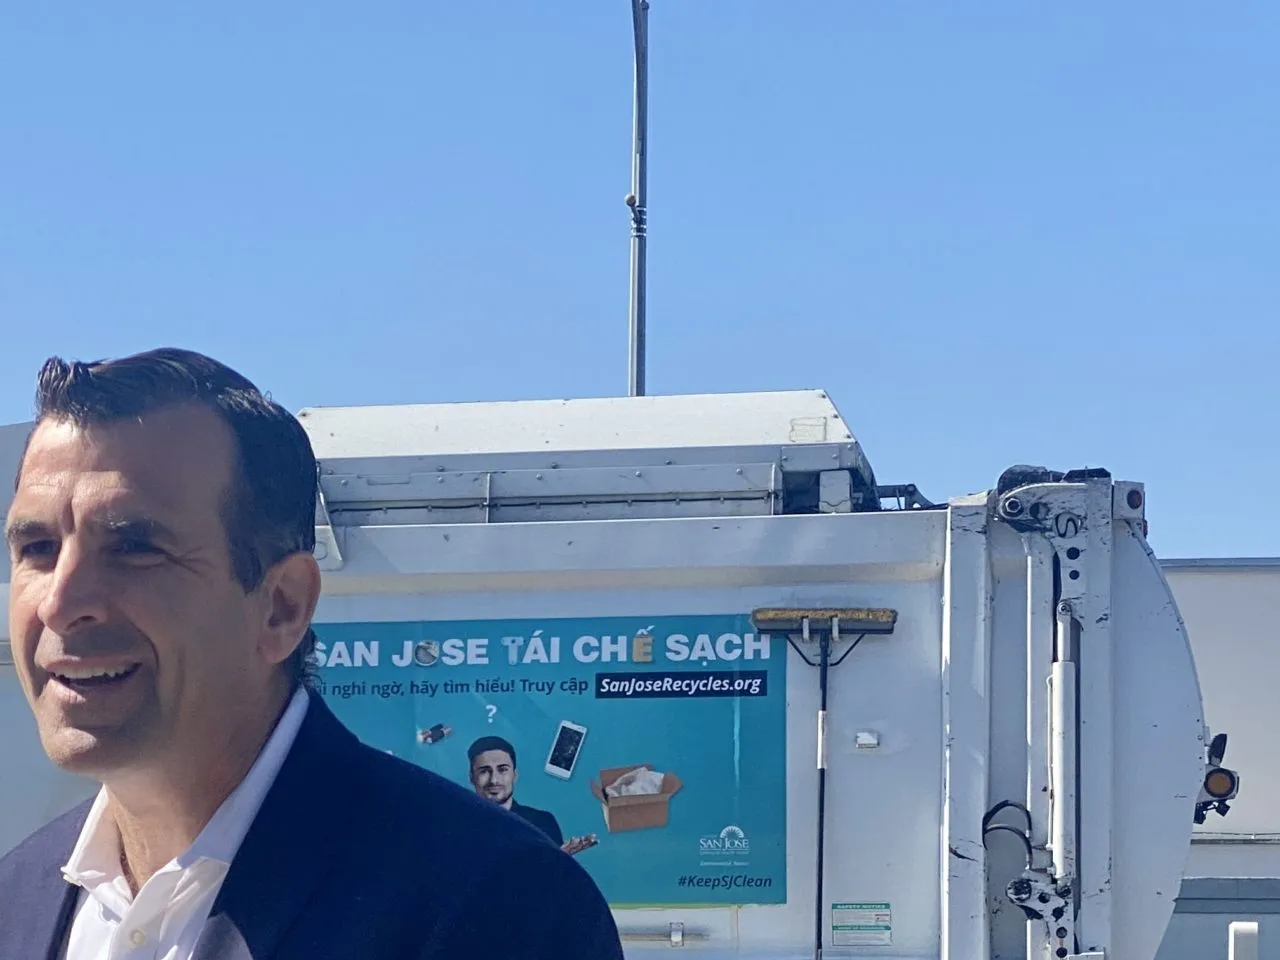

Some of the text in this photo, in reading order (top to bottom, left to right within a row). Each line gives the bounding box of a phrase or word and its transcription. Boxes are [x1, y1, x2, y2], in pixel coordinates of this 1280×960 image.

[392, 638, 489, 668] JOSE
[501, 630, 560, 666] TÁI
[573, 625, 654, 663] CHẾ
[666, 633, 770, 667] SẠCH
[332, 683, 366, 698] nghi
[410, 679, 438, 698] hãy
[443, 679, 469, 694] tìm
[520, 679, 555, 695] Truy
[560, 677, 588, 696] cập
[600, 677, 762, 695] SanJoseRecycles.org
[700, 837, 749, 851] SAN JOSE
[678, 875, 773, 890] #KeepSJClean
